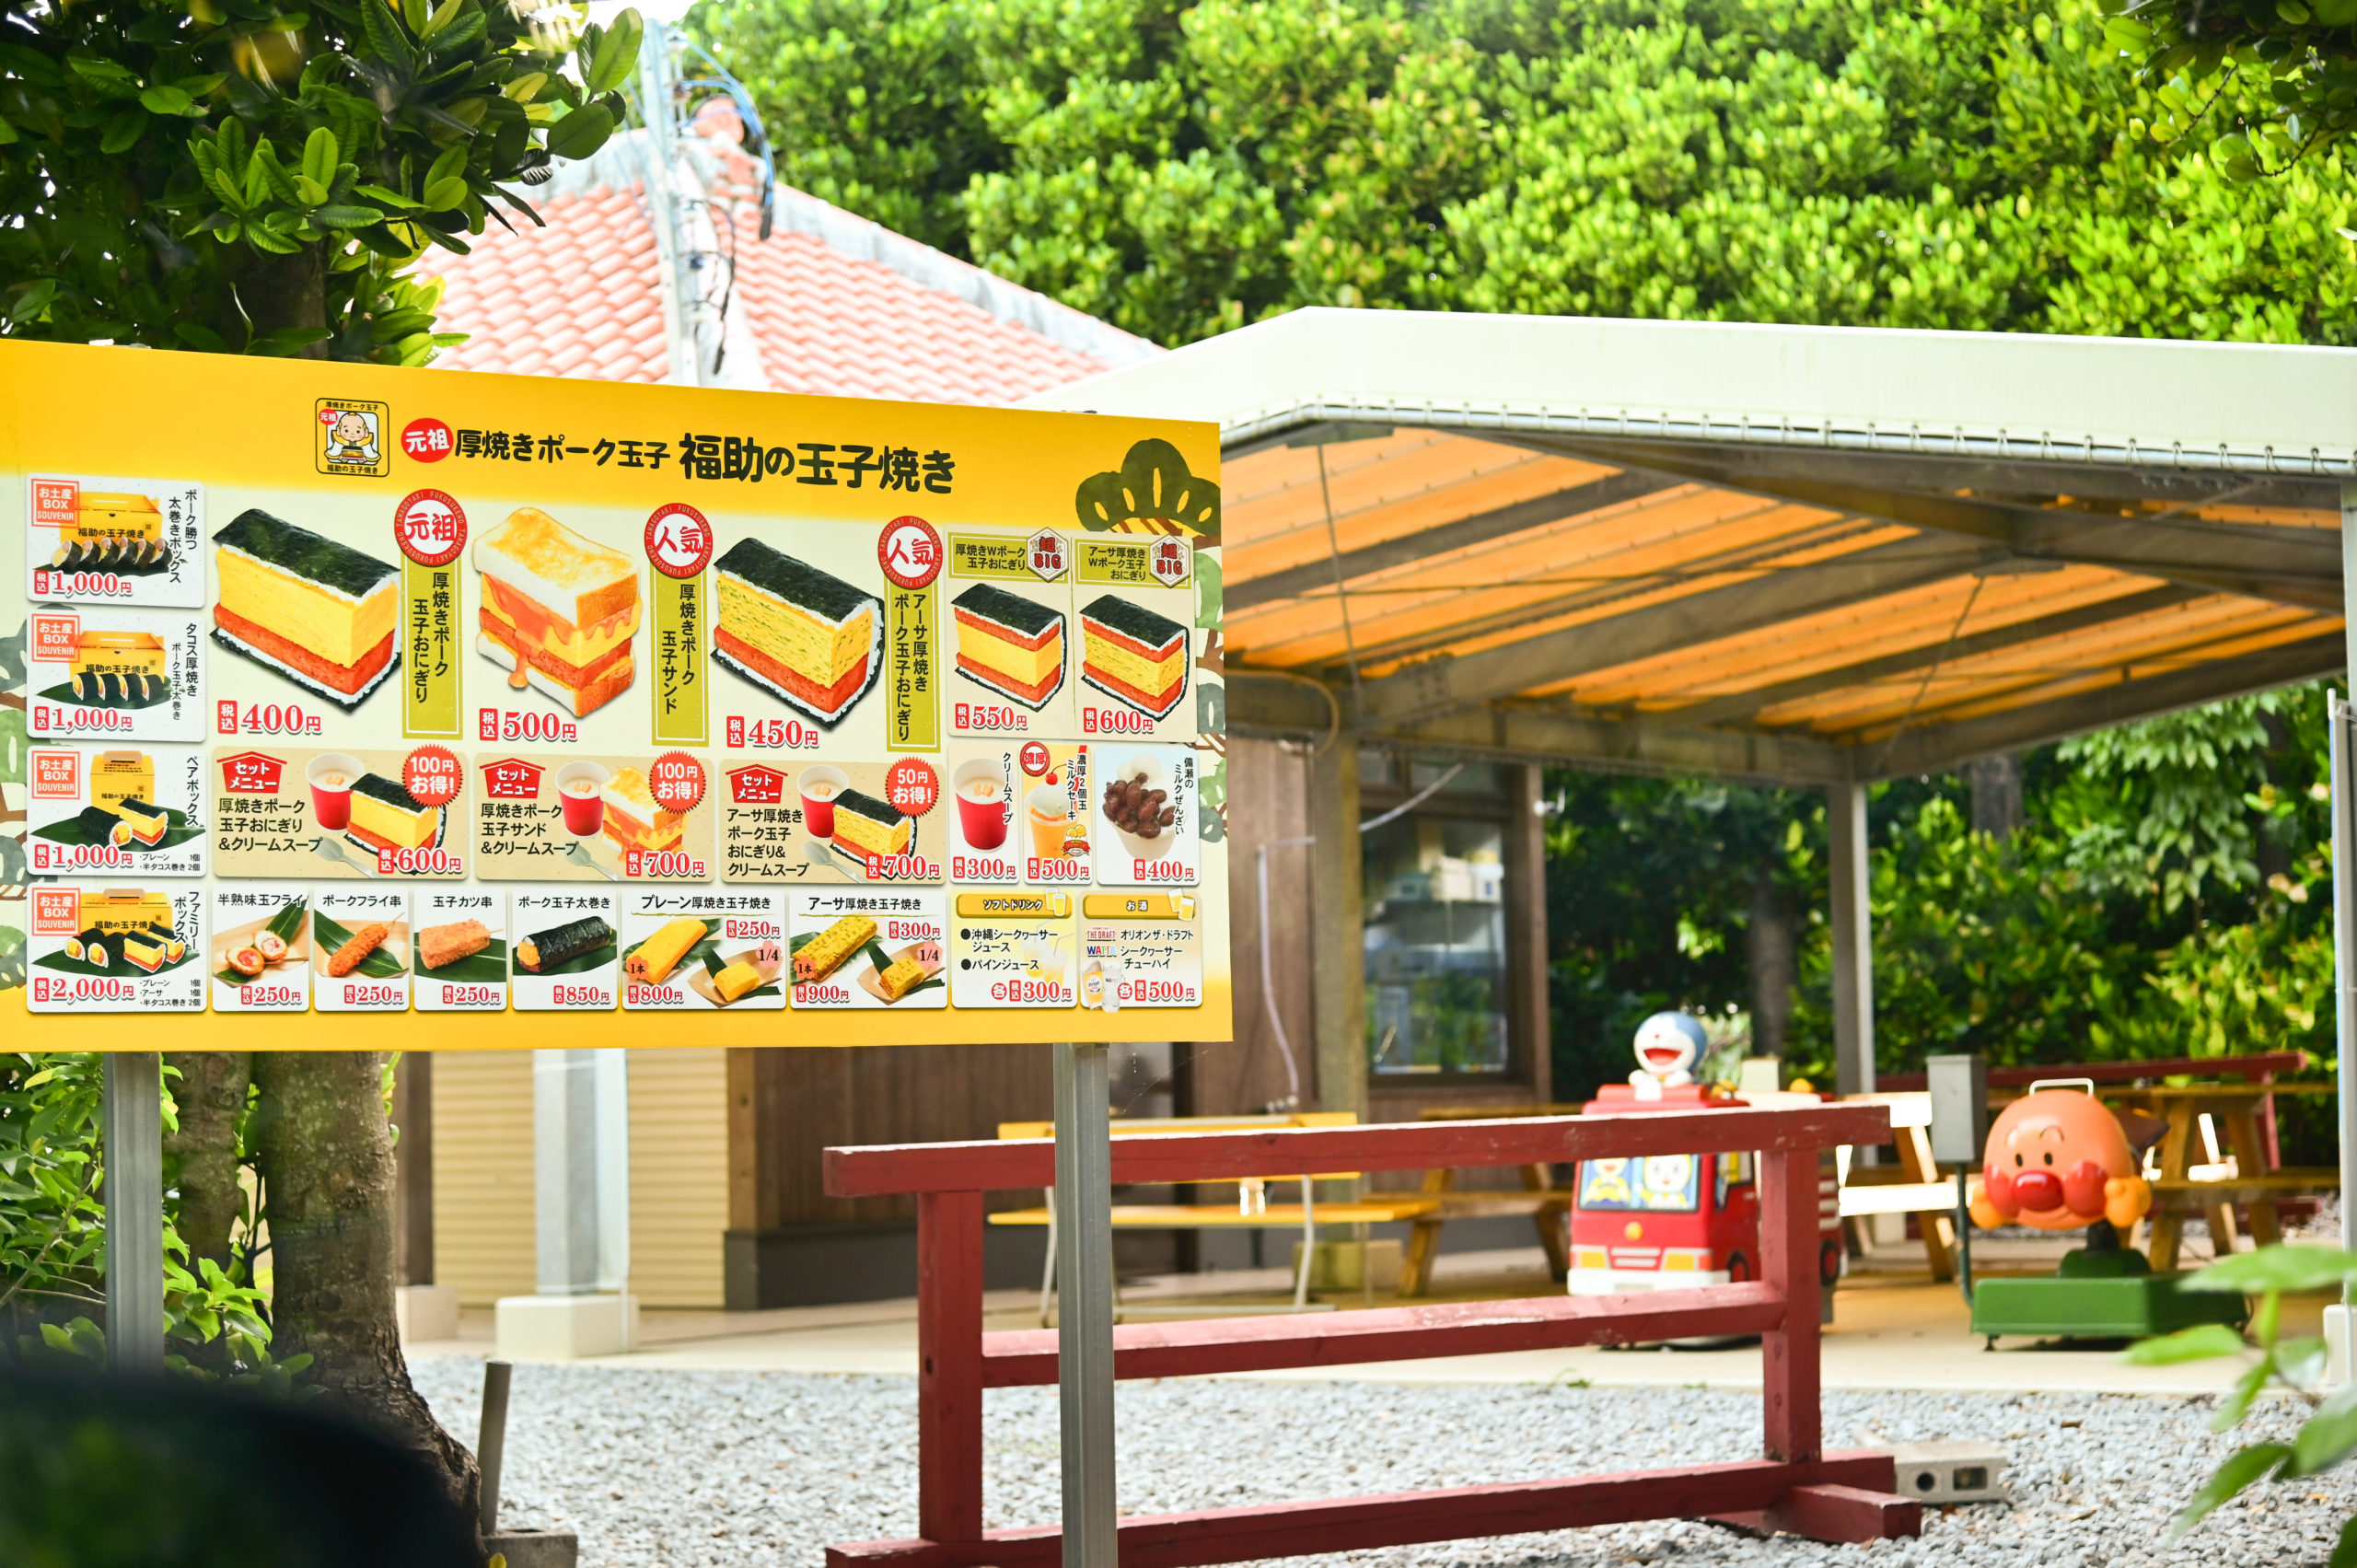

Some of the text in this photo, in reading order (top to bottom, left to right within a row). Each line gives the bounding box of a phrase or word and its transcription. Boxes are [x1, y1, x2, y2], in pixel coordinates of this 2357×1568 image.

[325, 401, 378, 411] 厚焼きポーク玉子
[319, 412, 337, 422] 元祖
[405, 428, 956, 494] 元祖 厚焼きポーク玉子 福助の玉子焼き
[327, 464, 378, 474] 福助の玉子焼き
[39, 487, 73, 499] お土産
[42, 499, 69, 510] BOX
[37, 510, 75, 522] SOUVENIR
[185, 489, 198, 550] ポーク勝つ
[78, 528, 145, 538] 福助の玉子焼き
[406, 513, 455, 541] 元祖
[168, 497, 181, 583] 太巻きボックス
[656, 526, 702, 554] 人気
[888, 538, 933, 565] 人気
[956, 543, 1026, 557] 厚焼きWポーク
[1088, 546, 1146, 559] アーサ厚焼き
[967, 558, 1026, 571] 玉子おにぎり
[1034, 552, 1062, 569] BIG
[1088, 557, 1145, 570] Wポーク玉子
[1156, 560, 1183, 575] BIG
[1110, 569, 1146, 581] おにぎり
[36, 572, 132, 595] 税込 1,000円
[39, 621, 73, 634] お土産
[432, 572, 449, 677] 厚焼きポーク
[42, 633, 69, 645] BOX
[679, 584, 696, 686] 厚焼きポーク
[913, 594, 929, 691] アーサ厚焼き
[37, 645, 75, 656] SOUVENIR
[412, 598, 429, 703] 玉子おにぎり
[185, 623, 198, 697] タコス厚焼き
[895, 594, 911, 741] ポーク玉子おにぎり
[86, 663, 150, 674] 福助の玉子焼き
[661, 630, 678, 714] 玉子サンド
[172, 643, 182, 720] ポーク玉子太巻き
[36, 708, 132, 731] 税込 1,000円
[220, 703, 321, 732] 税込 400円
[957, 705, 1028, 728] 税込 550円
[1086, 710, 1154, 731] 税込 600円
[482, 711, 576, 738] 税込 500円
[729, 718, 819, 746] 税込 450円
[40, 759, 73, 771] お土産
[235, 761, 270, 775] セット
[410, 757, 454, 773] 100円
[656, 762, 698, 779] 100円
[1184, 757, 1194, 788] 備瀬の
[43, 771, 69, 782] BOX
[496, 768, 529, 781] セット
[741, 773, 772, 786] セット
[897, 768, 928, 784] 50円
[1077, 754, 1087, 810] 濃厚2個玉
[38, 783, 75, 793] SOUVENIR
[187, 756, 200, 826] ペアボックス
[230, 777, 277, 790] メニュー
[411, 777, 454, 795] お得!
[491, 783, 537, 796] メニュー
[657, 781, 698, 799] お得!
[1003, 752, 1014, 824] クリームスープ
[1066, 760, 1077, 820] ミルクセーキ
[737, 788, 780, 800] メニュー
[893, 785, 932, 805] お得!
[1174, 763, 1185, 835] ミルクぜんざい
[218, 797, 306, 814] 厚焼きポーク
[481, 803, 563, 819] 厚焼きポーク
[726, 807, 803, 823] アーサ厚焼き
[219, 818, 303, 833] 玉子おにぎり
[482, 822, 547, 837] 玉子サンド
[727, 826, 791, 841] ポーク玉子
[219, 836, 323, 853] &クリームスープ
[481, 841, 579, 855] &クリームスープ
[728, 844, 786, 858] おにぎり&
[36, 845, 133, 870] 税込 1,000円
[190, 854, 200, 862] 1個
[380, 848, 461, 872] 税込 600円
[628, 852, 705, 876] 税込 700円
[728, 863, 810, 877] クリームスープ
[868, 854, 940, 878] 税込 700円
[955, 858, 1016, 877] 税込 300円
[1028, 859, 1089, 878] 税込 500円
[1135, 861, 1193, 879] 税込 400円
[40, 896, 73, 908] お土産
[217, 893, 303, 907] 半熟味玉フライ
[322, 894, 401, 907] ポークフライ串
[433, 896, 492, 908] 玉子カツ串
[518, 896, 610, 909] ポーク玉子太巻き
[641, 895, 771, 909] プレーン厚焼き玉子焼き
[808, 897, 922, 910] アーサ厚焼き玉子焼き
[983, 900, 1043, 911] ソフトドリンク
[1126, 900, 1149, 912] お酒
[43, 907, 69, 918] BOX
[175, 897, 187, 943] ボックス
[189, 891, 201, 949] ファミリー
[38, 919, 75, 929] SOUVENIR
[739, 921, 780, 936] 250円
[889, 922, 940, 937] 税込 300円
[1087, 931, 1116, 939] THE DRAFT
[759, 949, 779, 961] 1/4
[920, 949, 939, 961] 1/4
[973, 942, 1011, 953] ジュース
[1086, 946, 1117, 955] WATTA
[631, 963, 645, 974] 1本
[798, 963, 813, 973] 1本
[971, 959, 1039, 970] パインジュース
[1124, 958, 1170, 969] チューハイ
[36, 978, 134, 1002] 税込 2,000円
[191, 989, 201, 997] 1個
[254, 986, 301, 1003] 250円
[358, 986, 402, 1002] 250円
[456, 986, 499, 1002] 250円
[566, 986, 610, 1002] 850円
[641, 986, 683, 1001] 800円
[796, 985, 849, 1001] 税込 900円
[993, 981, 1071, 1000] 各 税込 300円
[1119, 981, 1195, 1000] 各 税込 500円
